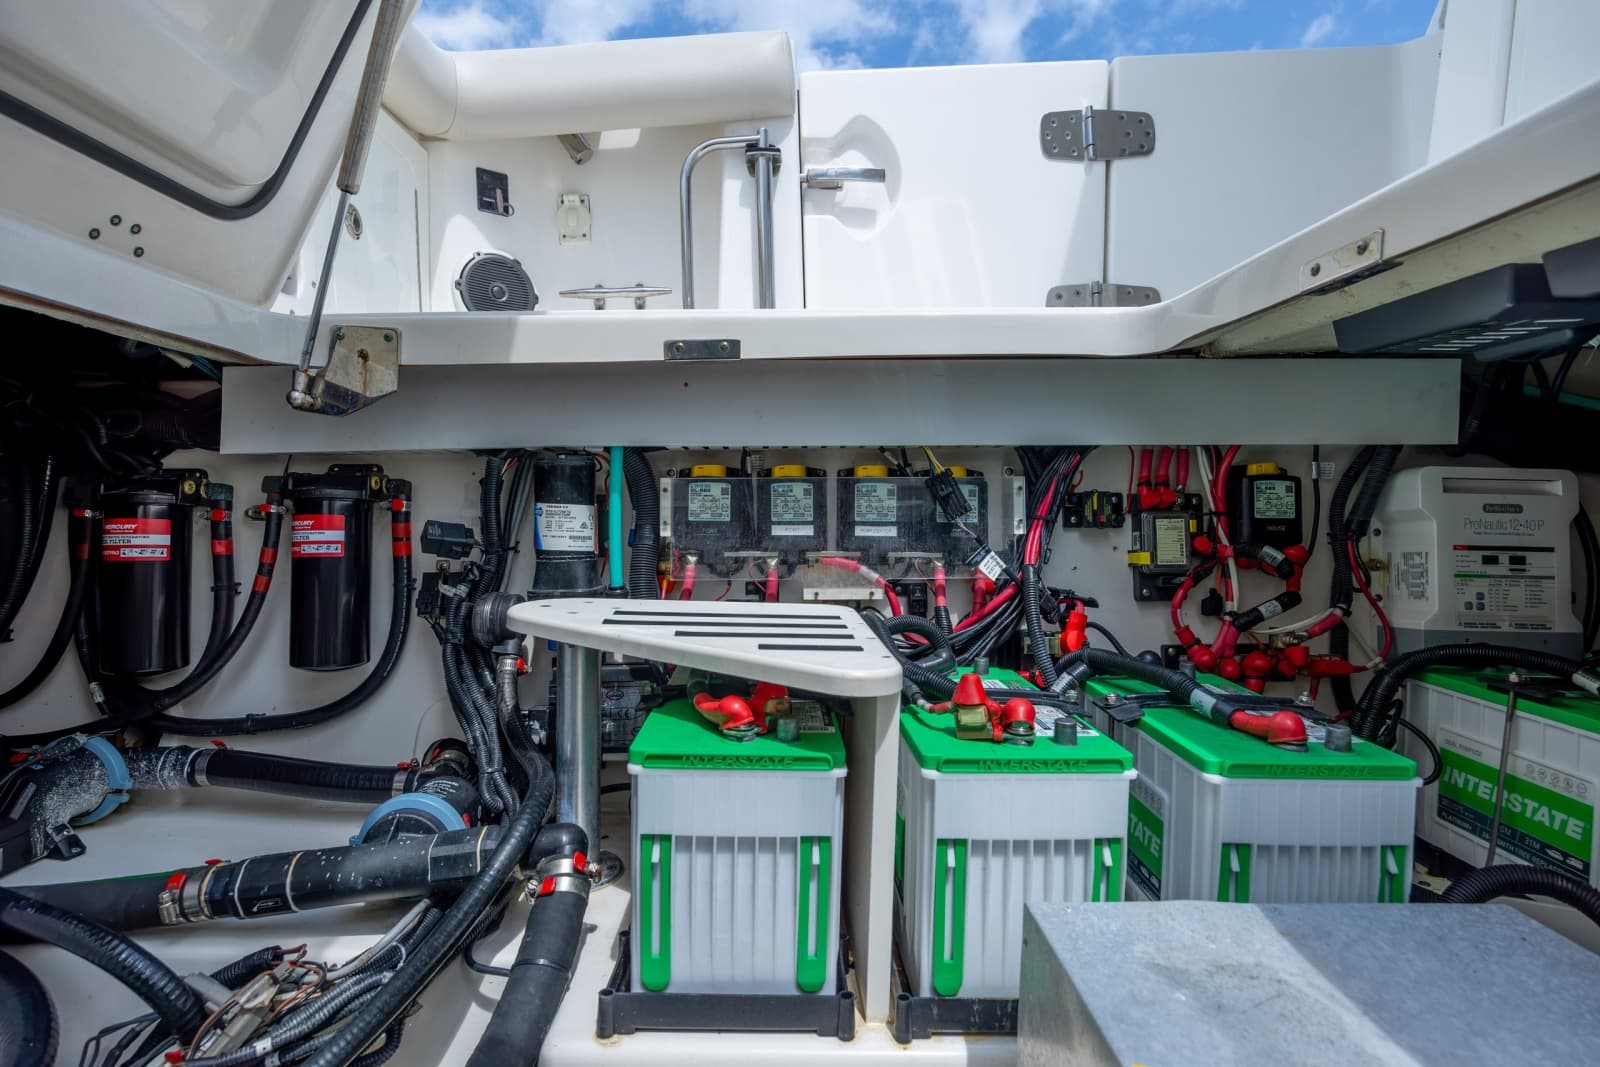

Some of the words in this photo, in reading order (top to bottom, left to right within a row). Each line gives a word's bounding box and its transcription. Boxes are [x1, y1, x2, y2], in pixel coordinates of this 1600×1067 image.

[682, 755, 793, 769] INTERSTATE
[978, 760, 1088, 772] INTERSTATE
[1265, 765, 1377, 777] INTERSTATE
